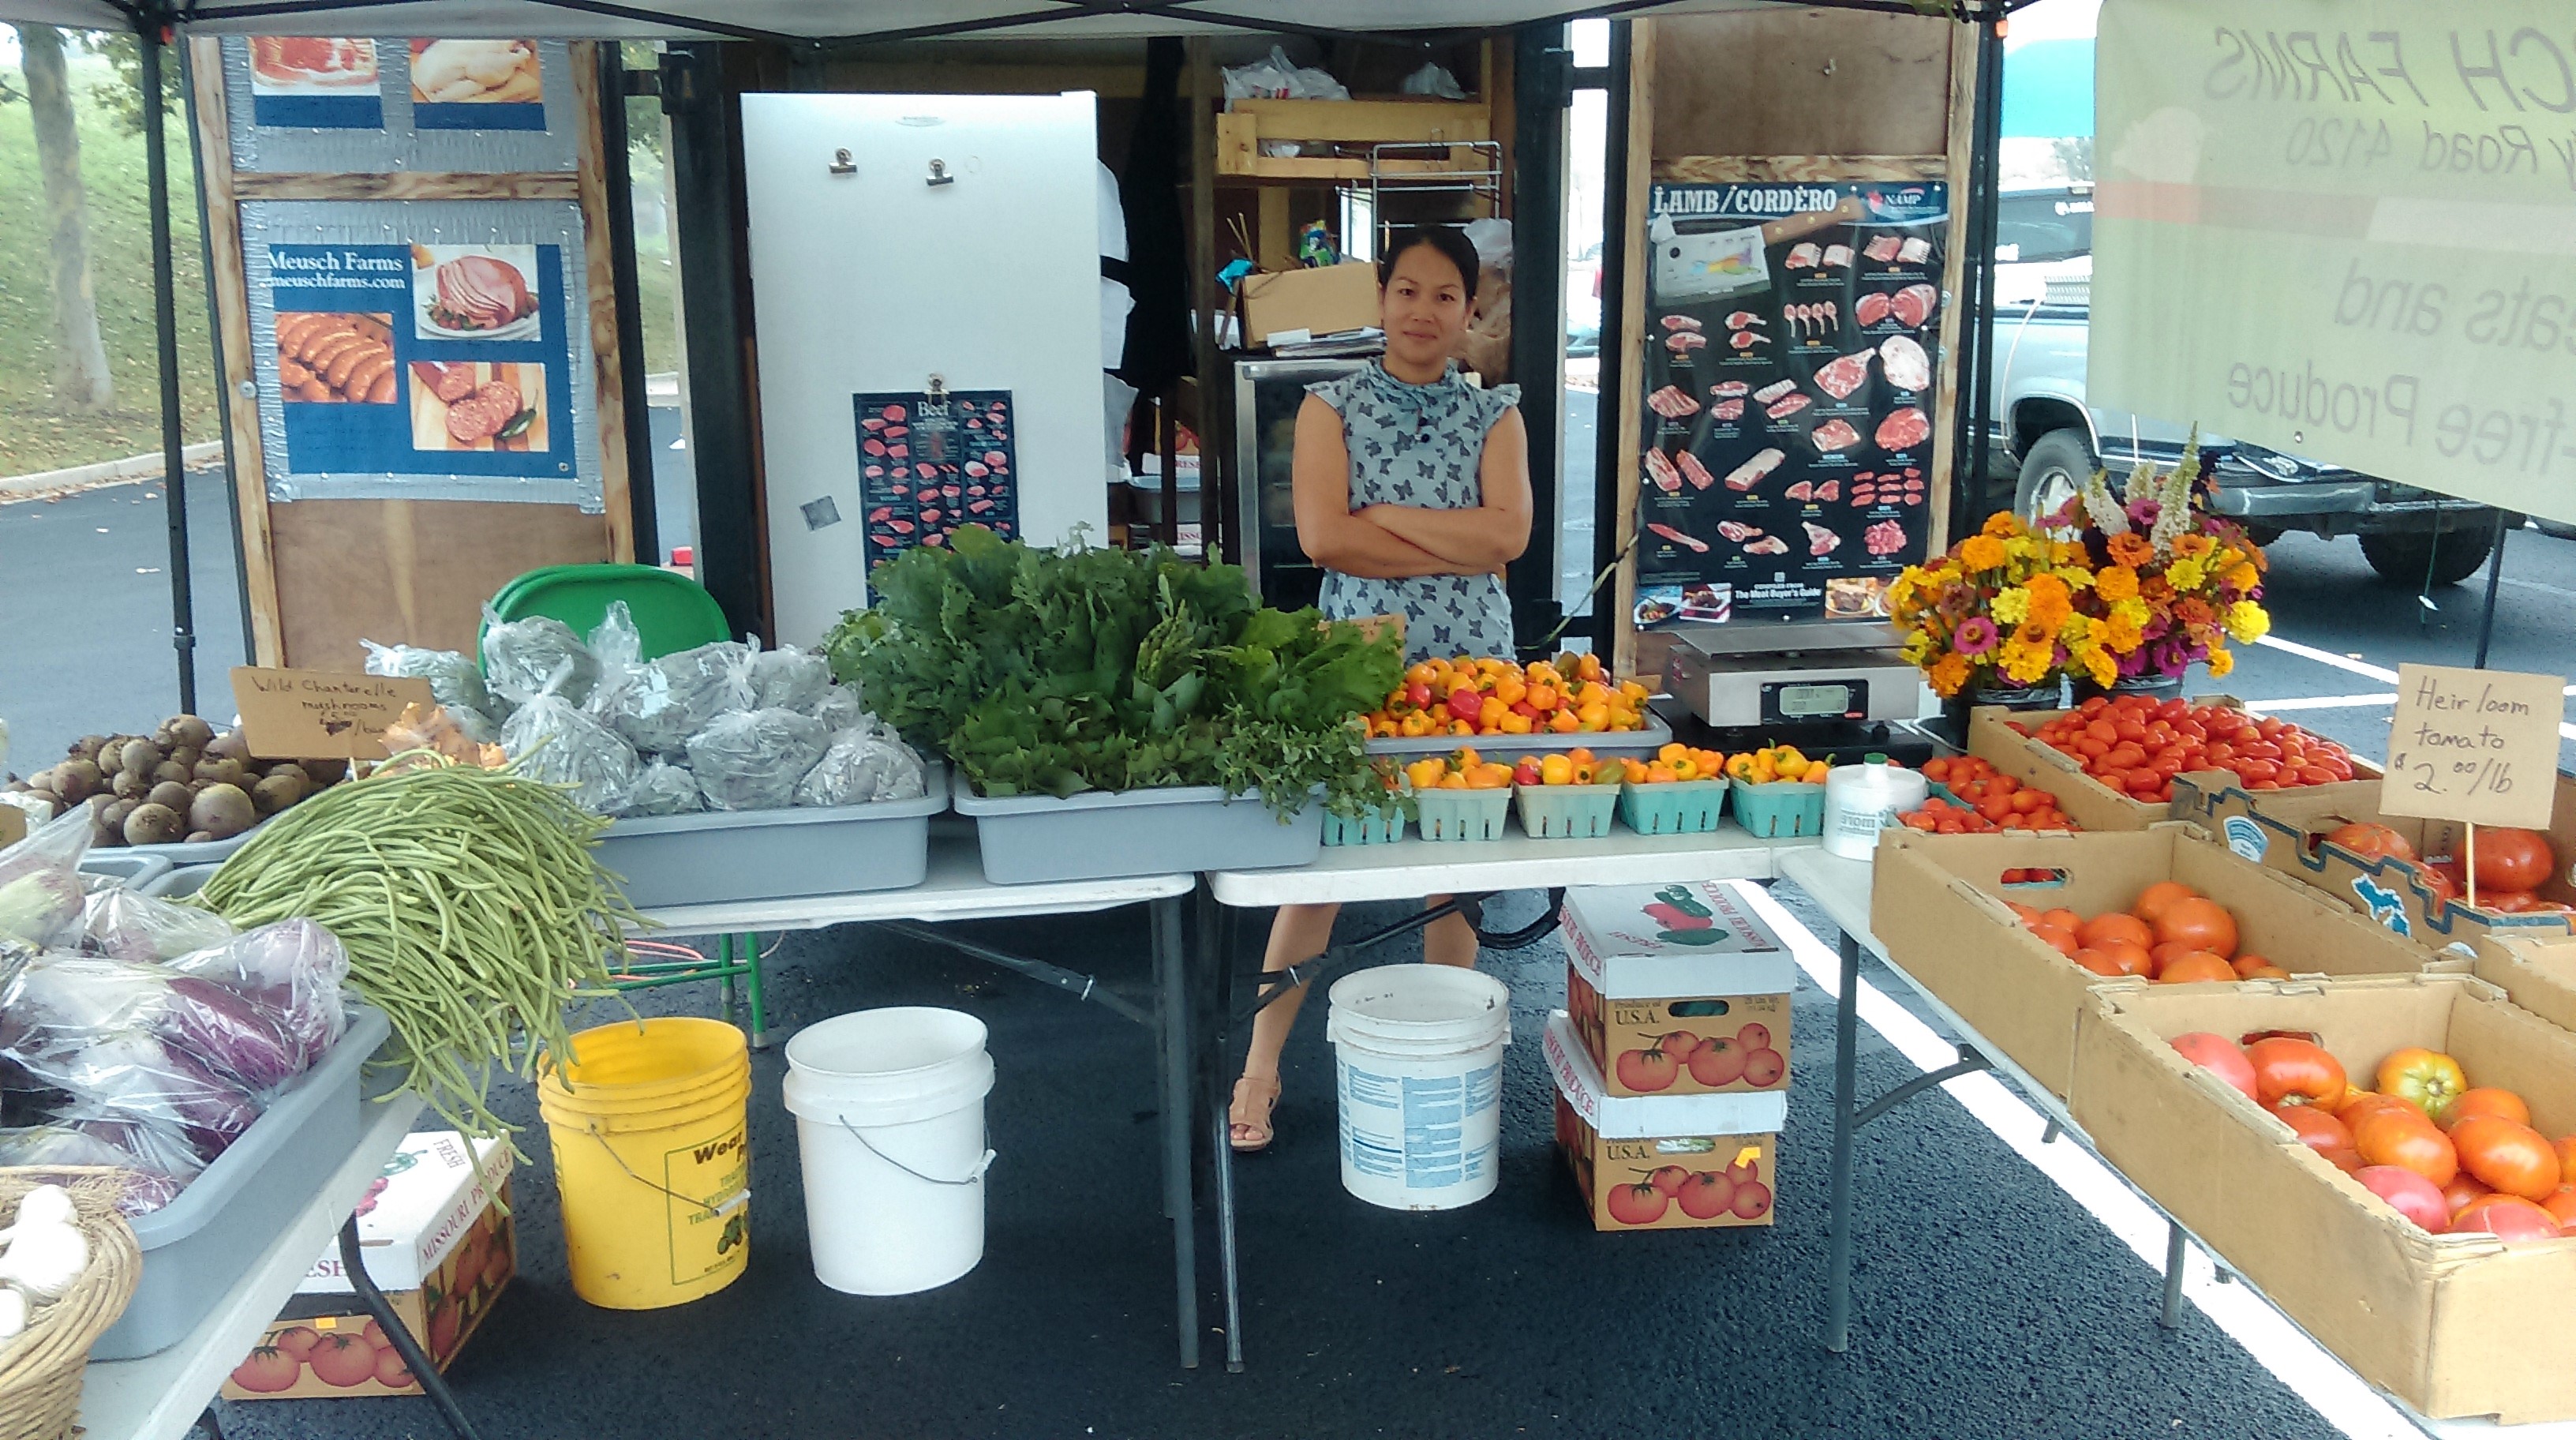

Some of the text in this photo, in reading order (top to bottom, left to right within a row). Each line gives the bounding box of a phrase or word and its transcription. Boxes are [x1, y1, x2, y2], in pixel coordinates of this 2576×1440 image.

[268, 251, 403, 272] Meusch Farms
[251, 676, 292, 692] Wild
[2413, 722, 2505, 750] tomato
[1616, 1010, 1660, 1026] U.S.A.
[433, 1138, 466, 1168] FRESH
[1607, 1145, 1650, 1161] U.S.A.
[422, 1146, 510, 1261] MISSOURI PRDUCE
